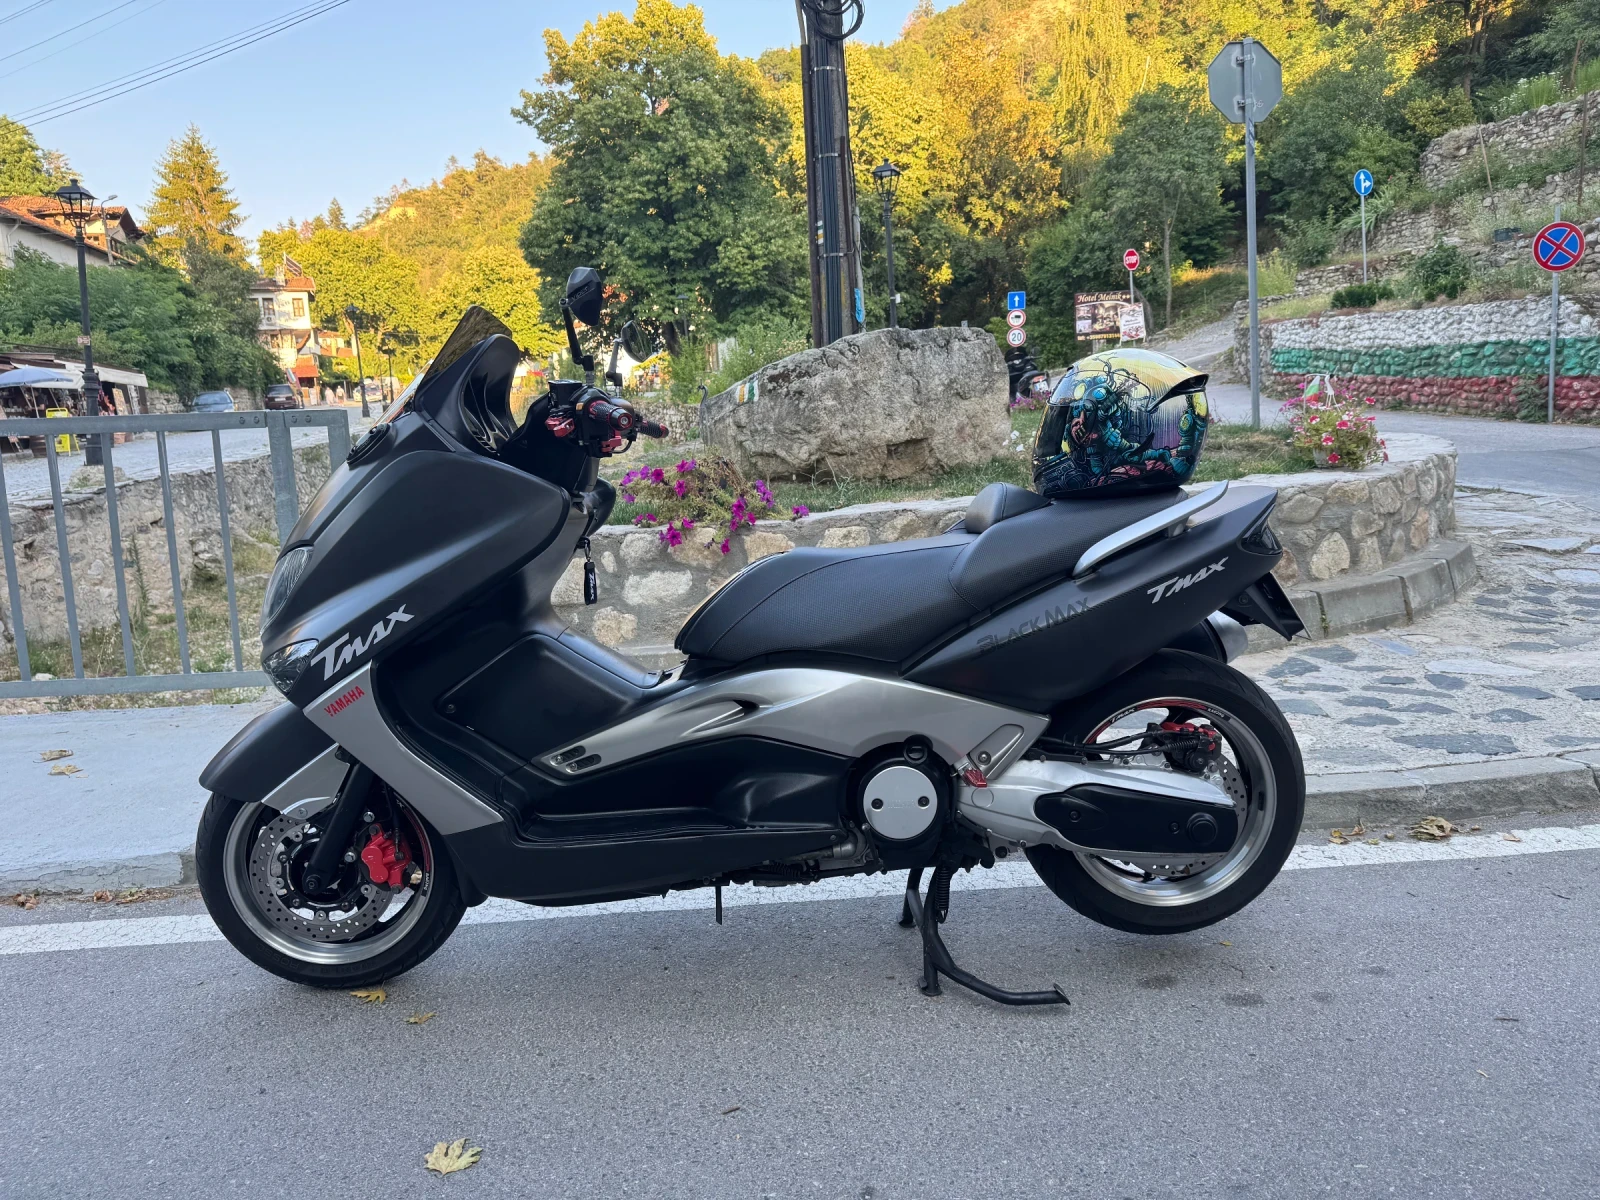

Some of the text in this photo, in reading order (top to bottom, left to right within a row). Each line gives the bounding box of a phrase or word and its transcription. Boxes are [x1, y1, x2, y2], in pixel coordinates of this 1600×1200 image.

[1125, 255, 1138, 264] STOP
[1077, 292, 1098, 303] Hotel
[1011, 332, 1022, 342] 20
[323, 685, 366, 717] YAMAHA
